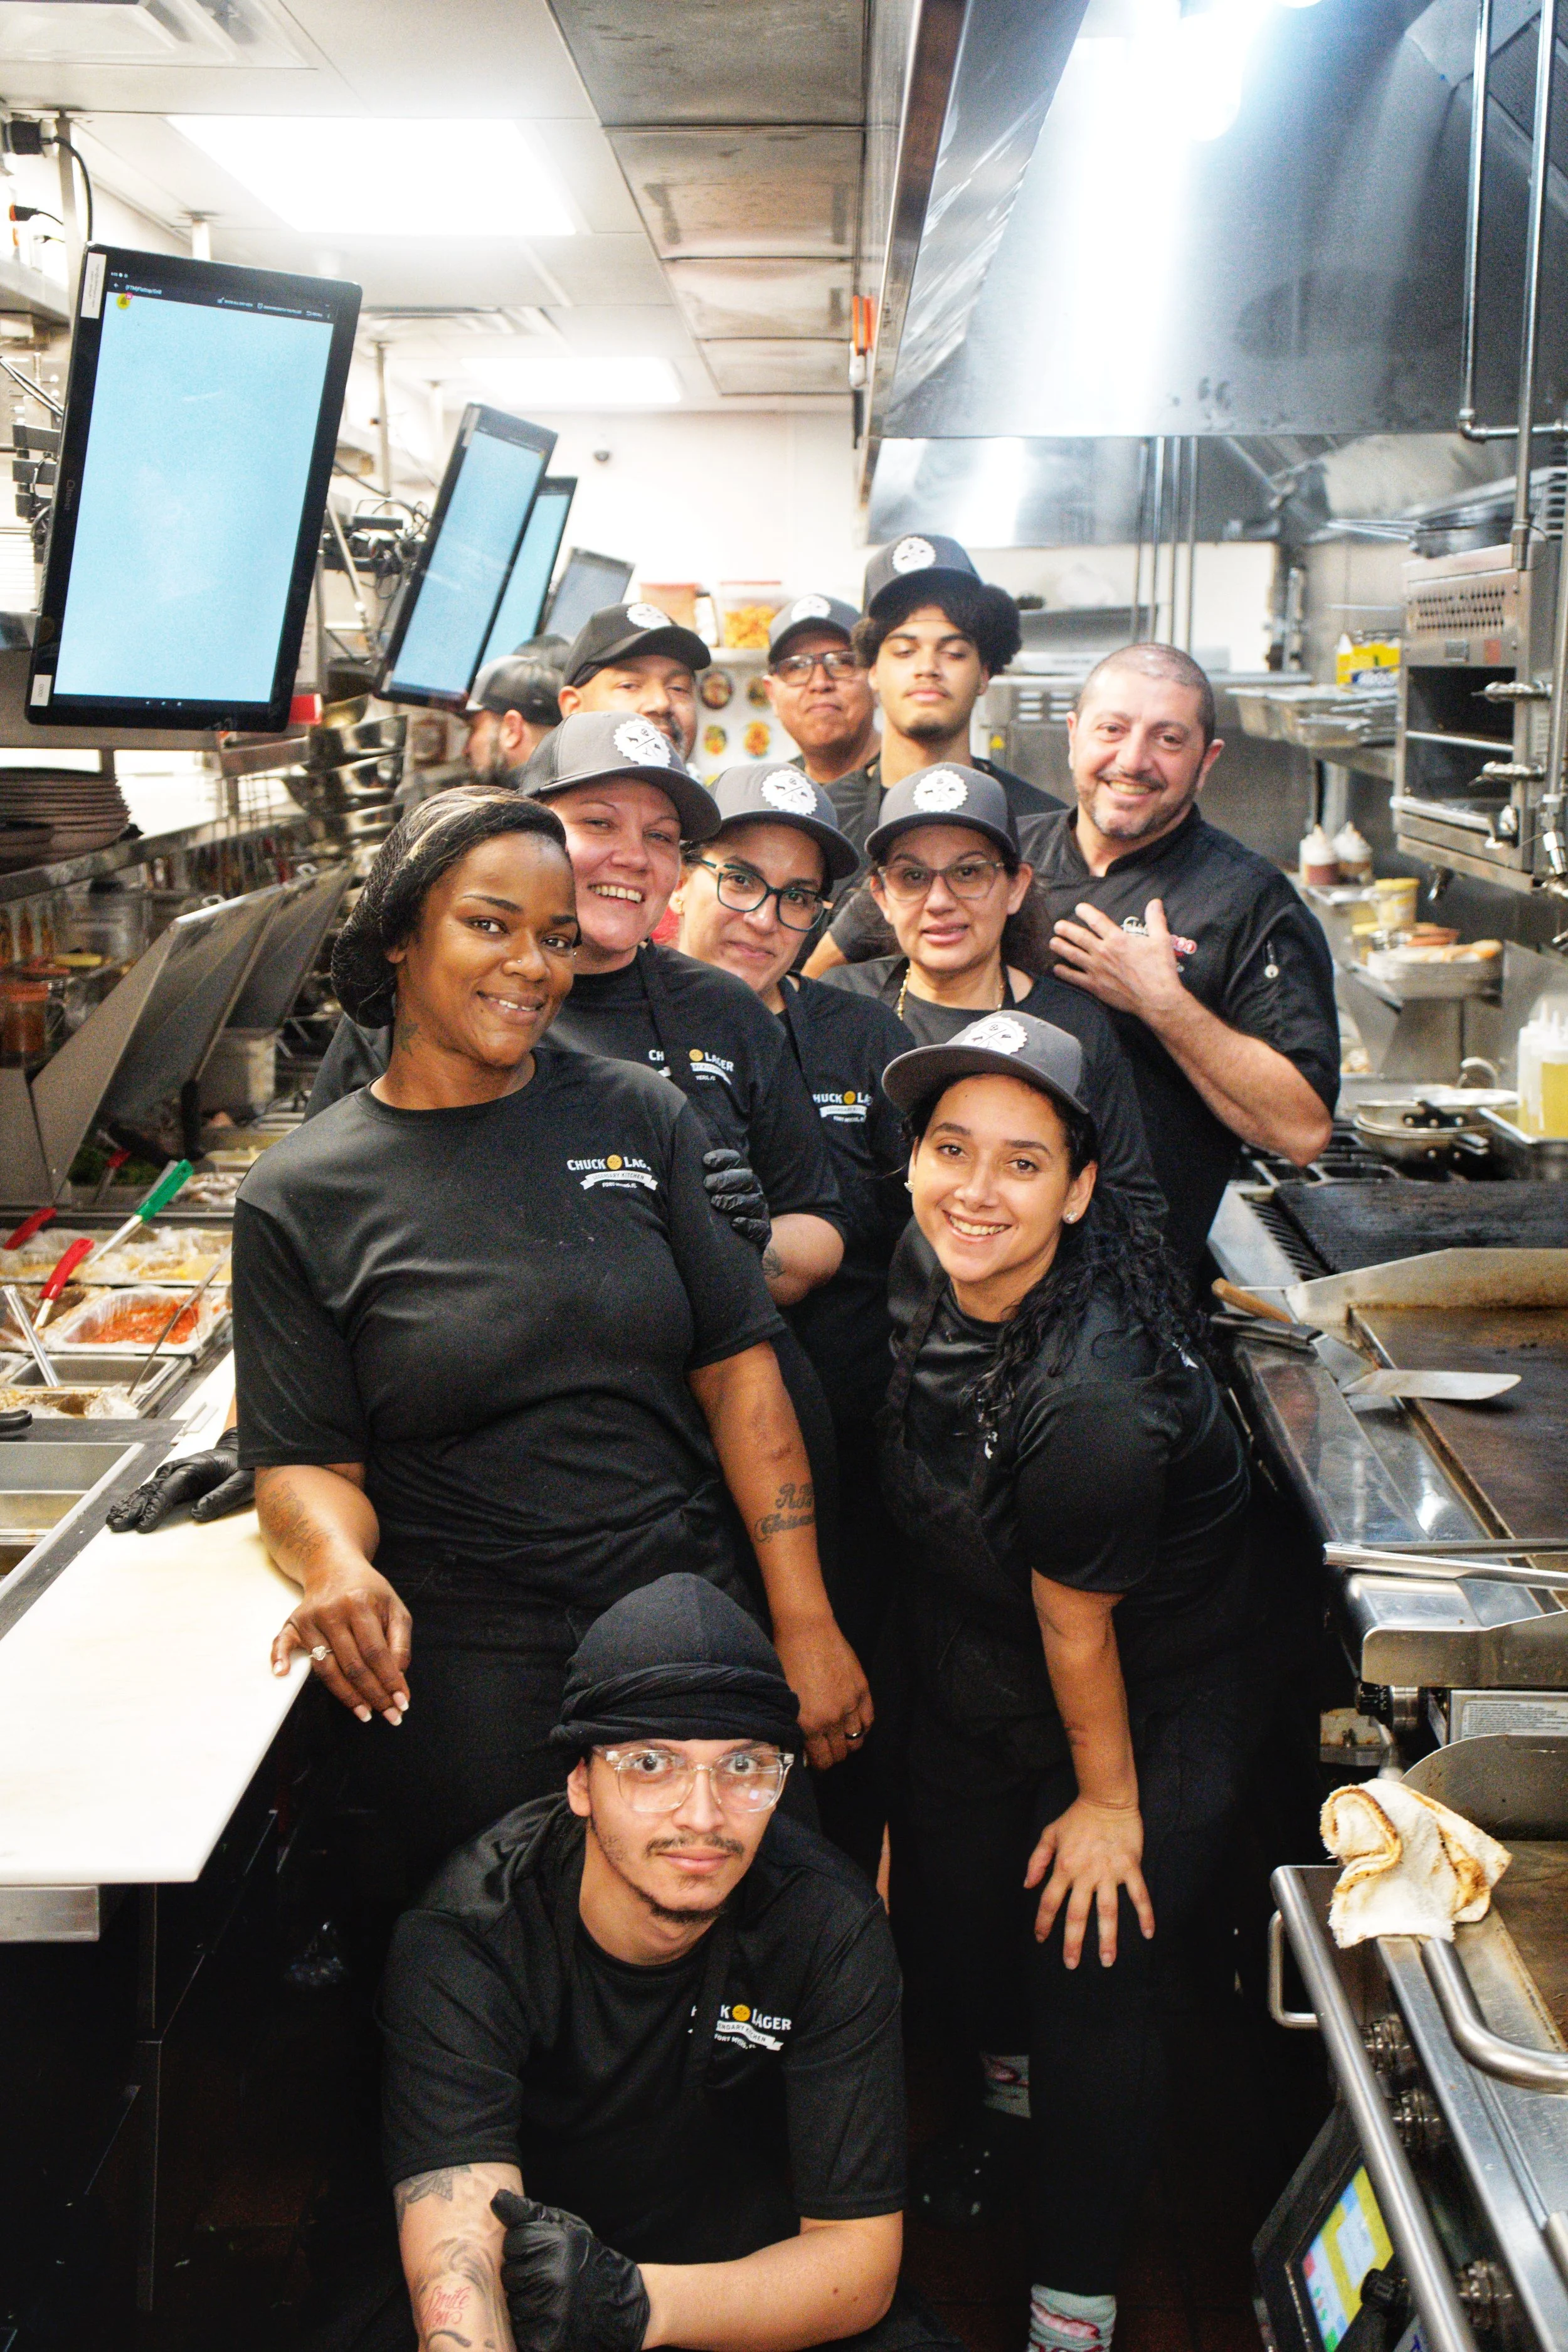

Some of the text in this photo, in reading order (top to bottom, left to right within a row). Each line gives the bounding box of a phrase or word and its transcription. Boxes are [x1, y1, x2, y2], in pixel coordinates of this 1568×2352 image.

[812, 1093, 842, 1104] HUCK
[566, 1158, 607, 1171] CHUCK
[751, 2008, 792, 2031] LAGER
[714, 2033, 731, 2042] FORT
